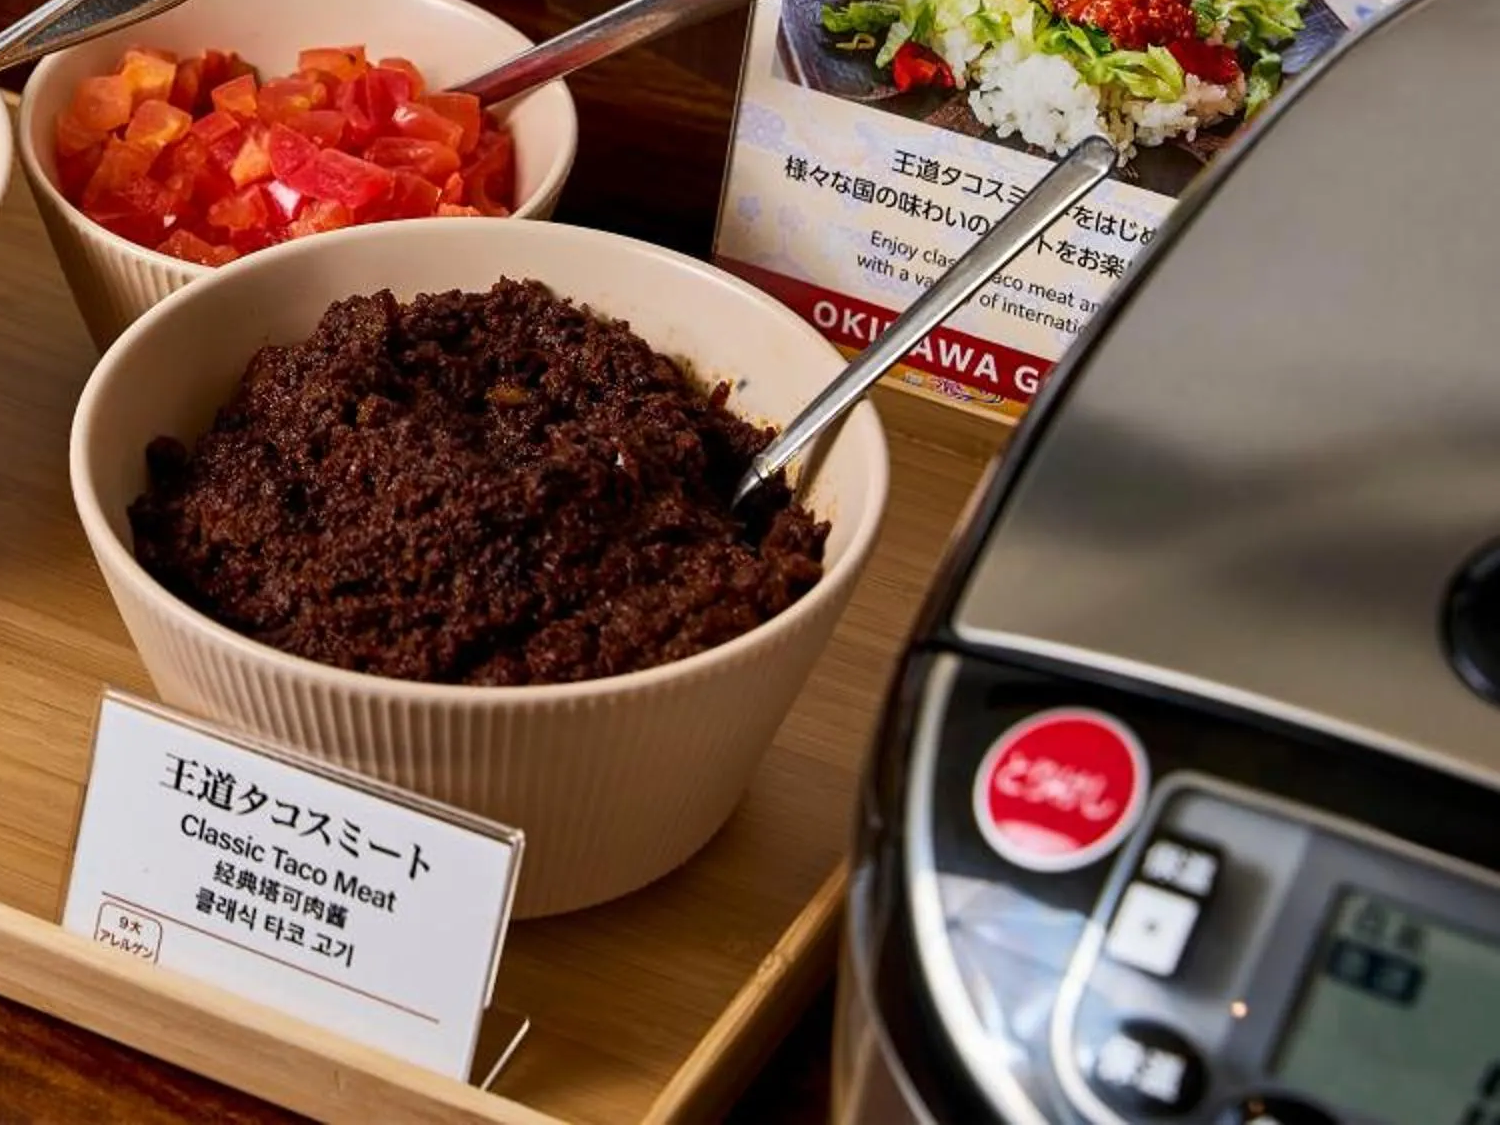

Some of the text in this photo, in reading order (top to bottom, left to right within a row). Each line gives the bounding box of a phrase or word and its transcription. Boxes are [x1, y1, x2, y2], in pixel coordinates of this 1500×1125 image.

[890, 147, 1158, 246] 王道タコスミをはじめ
[857, 251, 894, 278] with
[899, 269, 909, 282] a
[979, 291, 997, 308] of
[870, 229, 918, 260] Enjoy
[923, 246, 959, 269] clas
[991, 273, 1023, 292] aco
[1028, 282, 1075, 308] meat
[813, 300, 999, 383] OKIAWA
[159, 751, 432, 881] 王道タコスミート
[180, 813, 398, 914] Classic Taco Meat
[213, 859, 349, 931] 经典塔可肉酱
[99, 928, 155, 959] アレルゲン
[118, 915, 143, 936] 9大
[196, 888, 355, 969] 클래식 타코 고기
